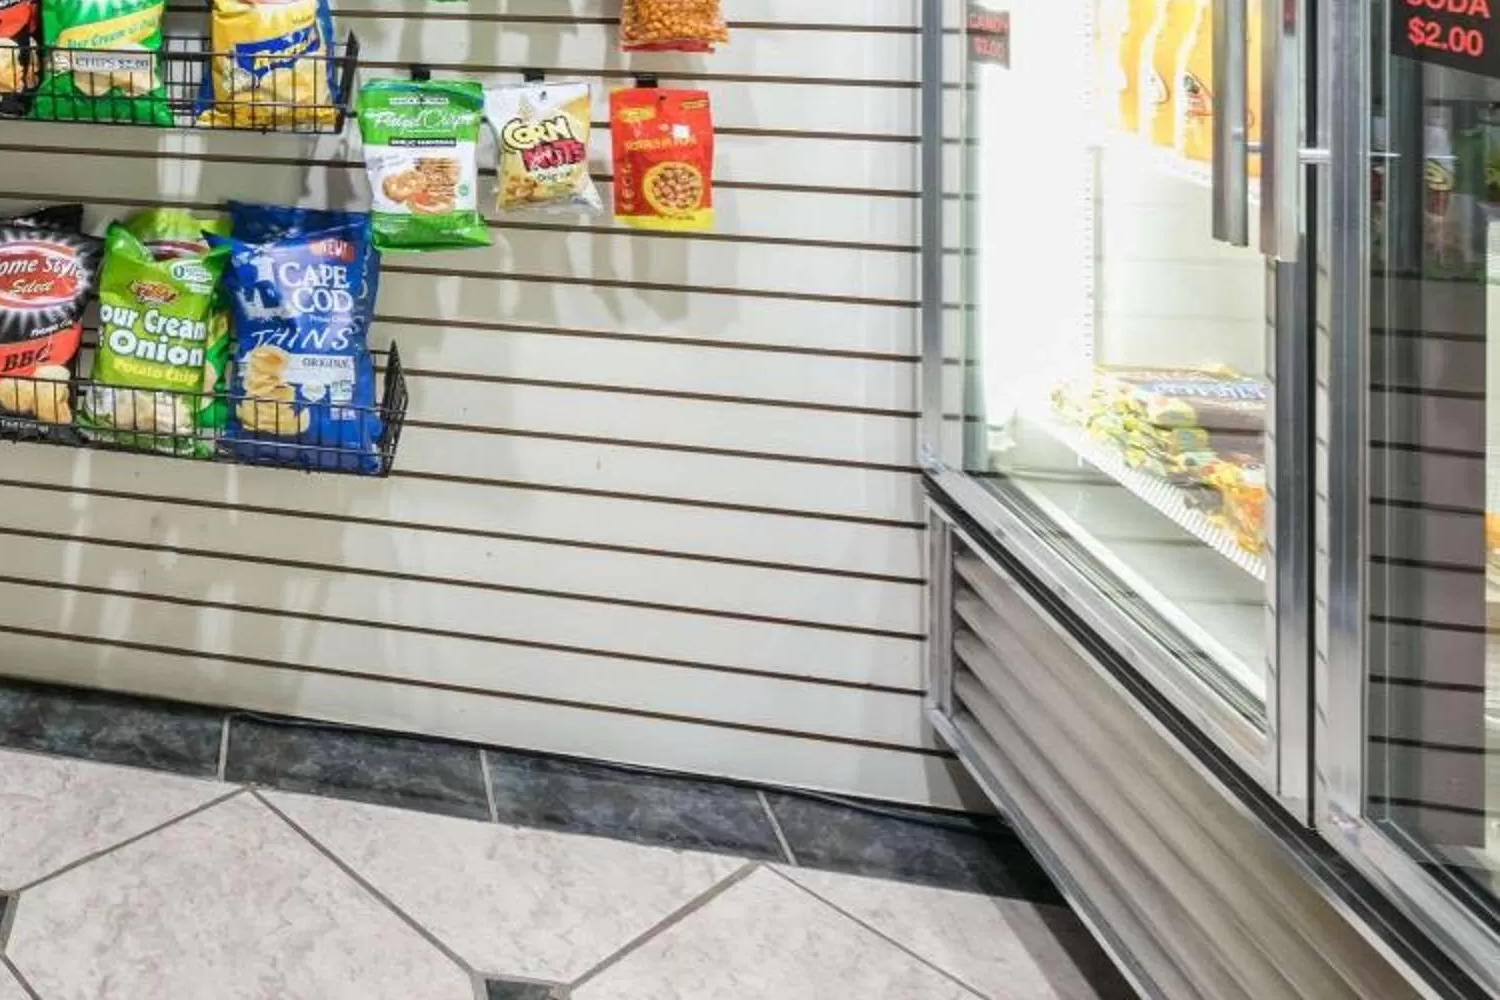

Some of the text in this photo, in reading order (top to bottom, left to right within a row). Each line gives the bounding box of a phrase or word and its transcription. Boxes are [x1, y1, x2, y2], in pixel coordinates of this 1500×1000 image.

[1407, 15, 1485, 57] $2.00
[502, 116, 572, 150] CORN
[41, 254, 86, 279] Style
[279, 262, 351, 289] CAPE
[12, 279, 54, 295] Select
[292, 288, 354, 313] COD
[100, 303, 139, 328] our
[109, 329, 205, 367] Onion
[250, 327, 355, 350] THINS
[164, 366, 199, 385] Chip
